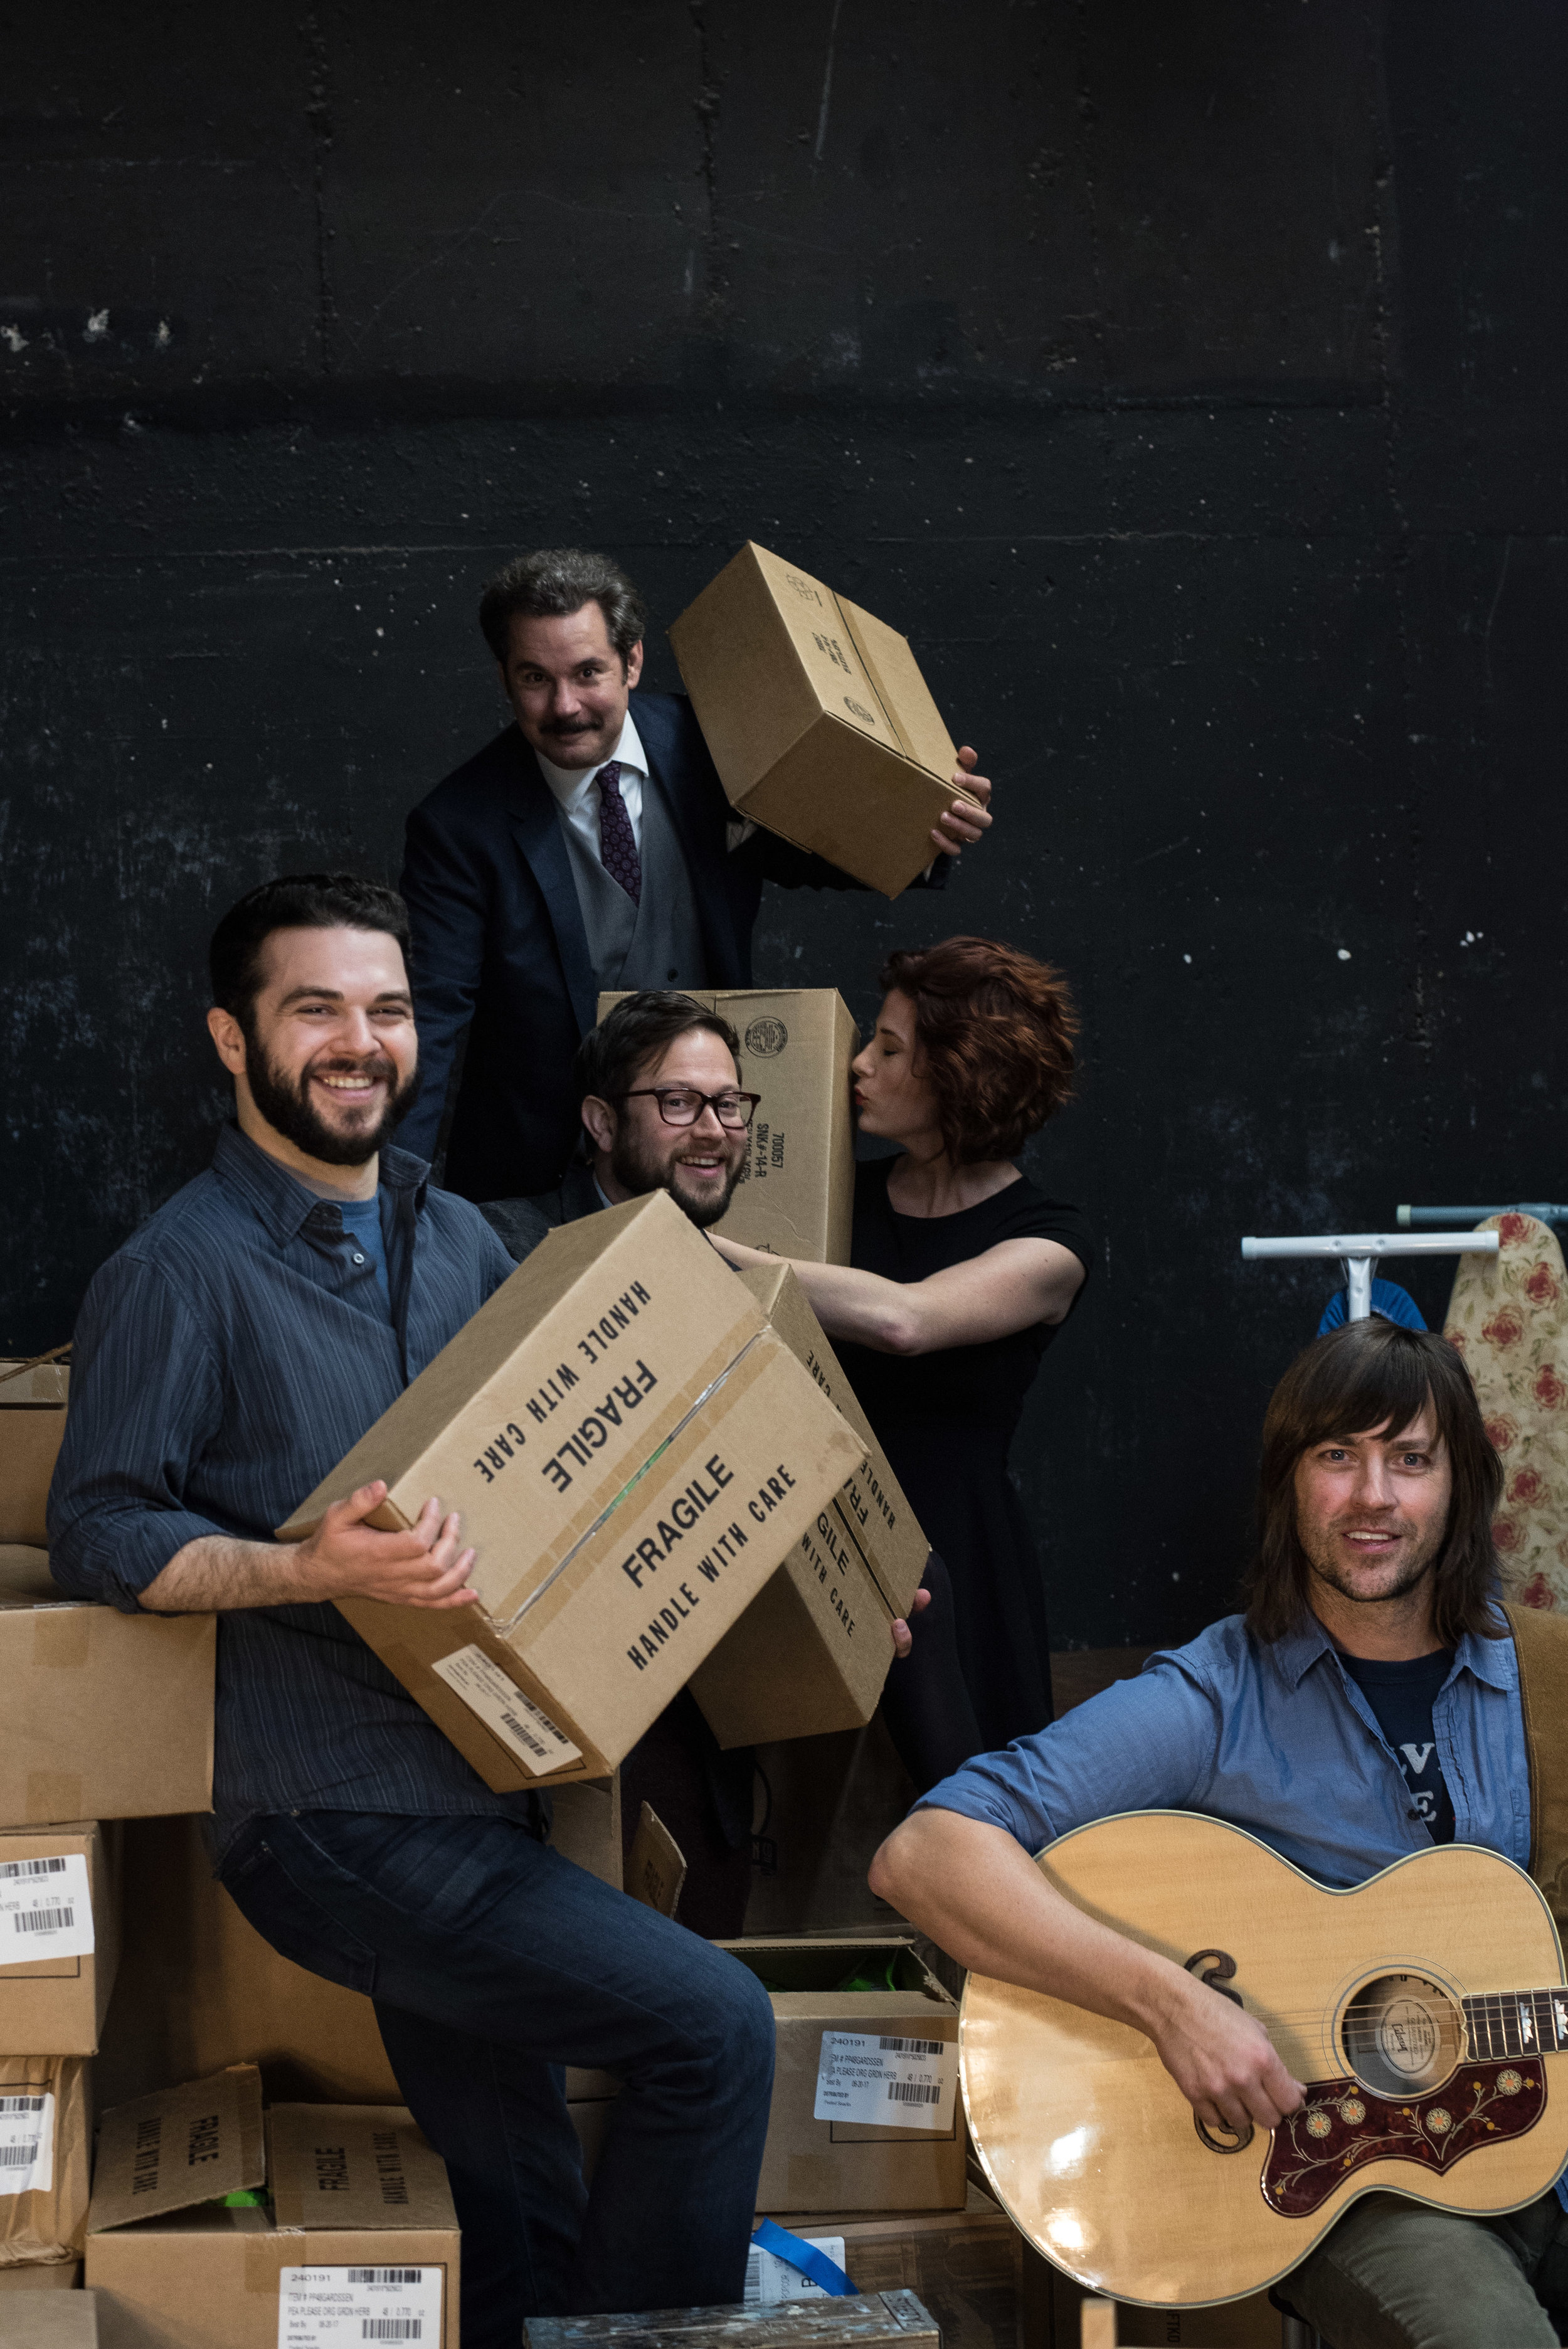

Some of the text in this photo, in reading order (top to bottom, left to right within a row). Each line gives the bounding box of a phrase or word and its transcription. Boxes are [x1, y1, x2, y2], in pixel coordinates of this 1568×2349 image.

[771, 1132, 784, 1168] 700057
[474, 1280, 651, 1483] HANDLE WITH CARE
[807, 1350, 831, 1397] CARE
[541, 1359, 658, 1493] FRAGILE
[622, 1454, 734, 1589] FRAGILE
[627, 1464, 796, 1671] HANDLE WITH CARE
[802, 1532, 855, 1638] WITH CARE
[830, 2037, 866, 2047] 240191
[1391, 2023, 1408, 2053] Gibson
[188, 2115, 219, 2166] FRAGILE
[315, 2148, 350, 2191] FRAGILE
